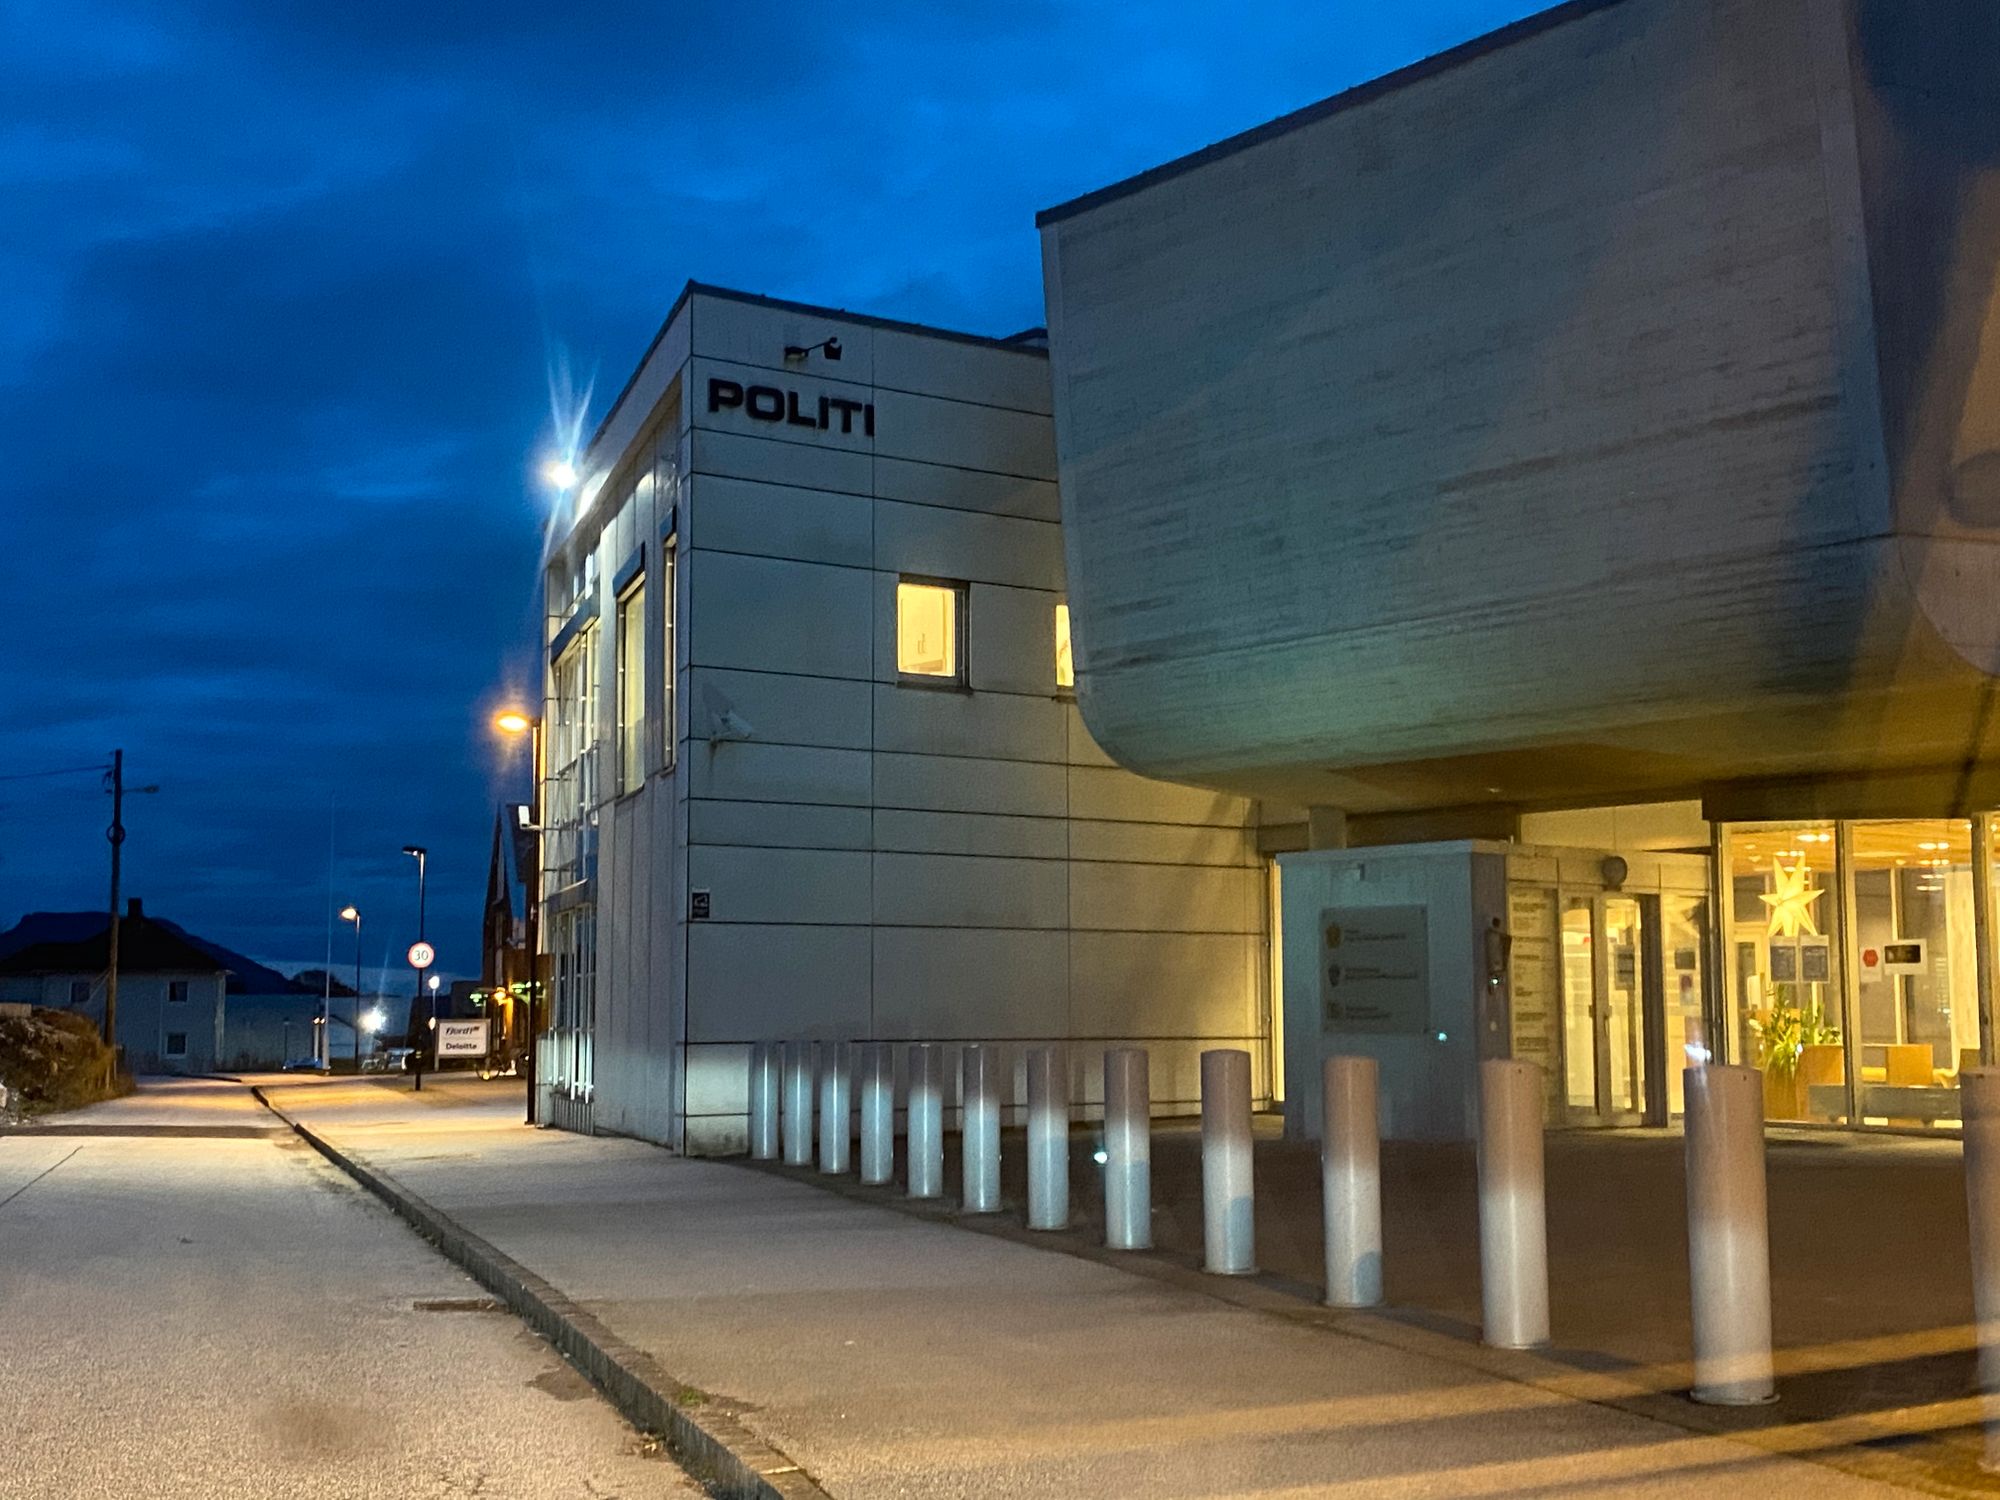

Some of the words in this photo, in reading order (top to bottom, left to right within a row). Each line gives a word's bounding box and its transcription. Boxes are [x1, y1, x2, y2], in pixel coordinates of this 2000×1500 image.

[708, 378, 875, 437] POLITI
[414, 950, 429, 961] 30
[446, 1042, 477, 1050] Deloitte
